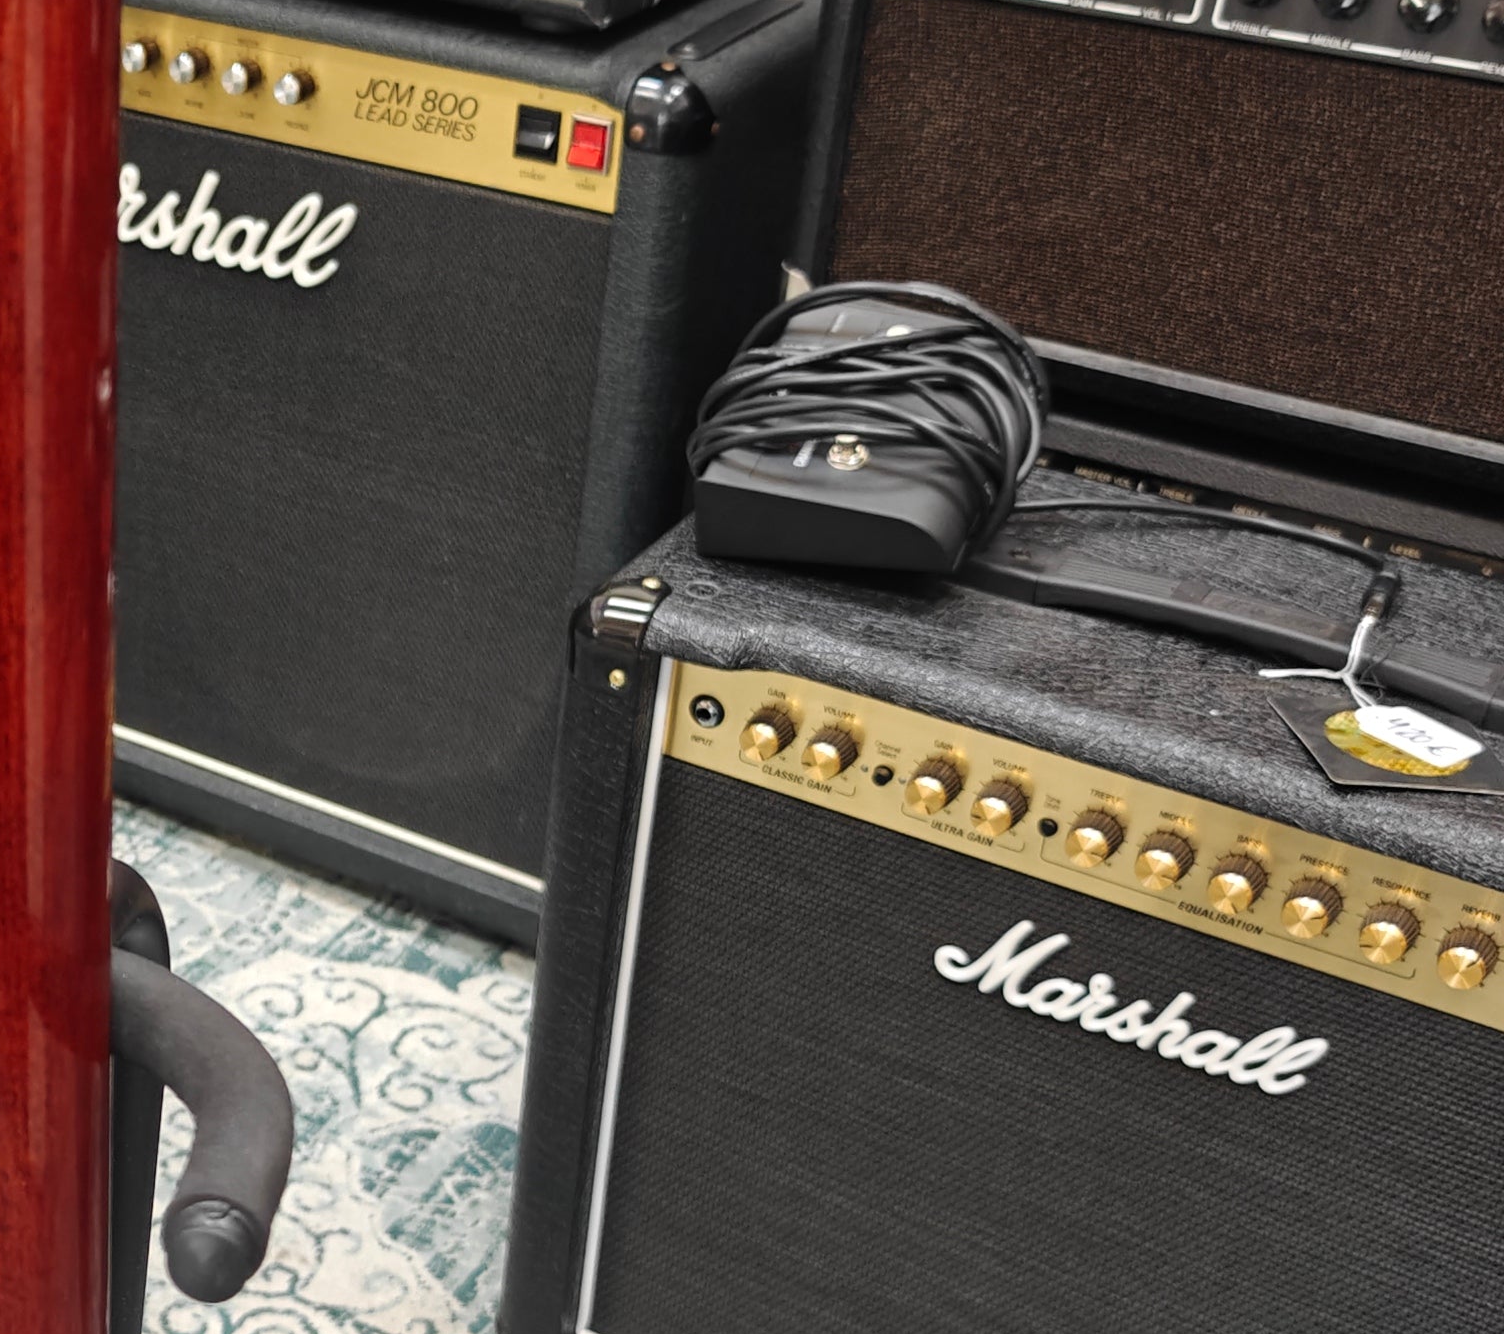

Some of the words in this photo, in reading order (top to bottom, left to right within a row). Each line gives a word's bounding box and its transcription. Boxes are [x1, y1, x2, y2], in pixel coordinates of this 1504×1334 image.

[355, 77, 415, 108] JCM
[421, 88, 479, 121] 800
[354, 101, 407, 128] LEAD
[412, 113, 477, 142] SERIES
[117, 163, 358, 288] rshall
[767, 687, 787, 701] GAIN
[823, 704, 857, 720] VOLUME
[761, 764, 804, 787] CLASSIC
[806, 779, 833, 794] GAIN
[992, 758, 1027, 773] VOLUME
[930, 819, 965, 839] ULTRA
[966, 829, 994, 847] GAIN
[1176, 900, 1264, 935] EQUALISATION
[934, 919, 1330, 1095] Marshall
